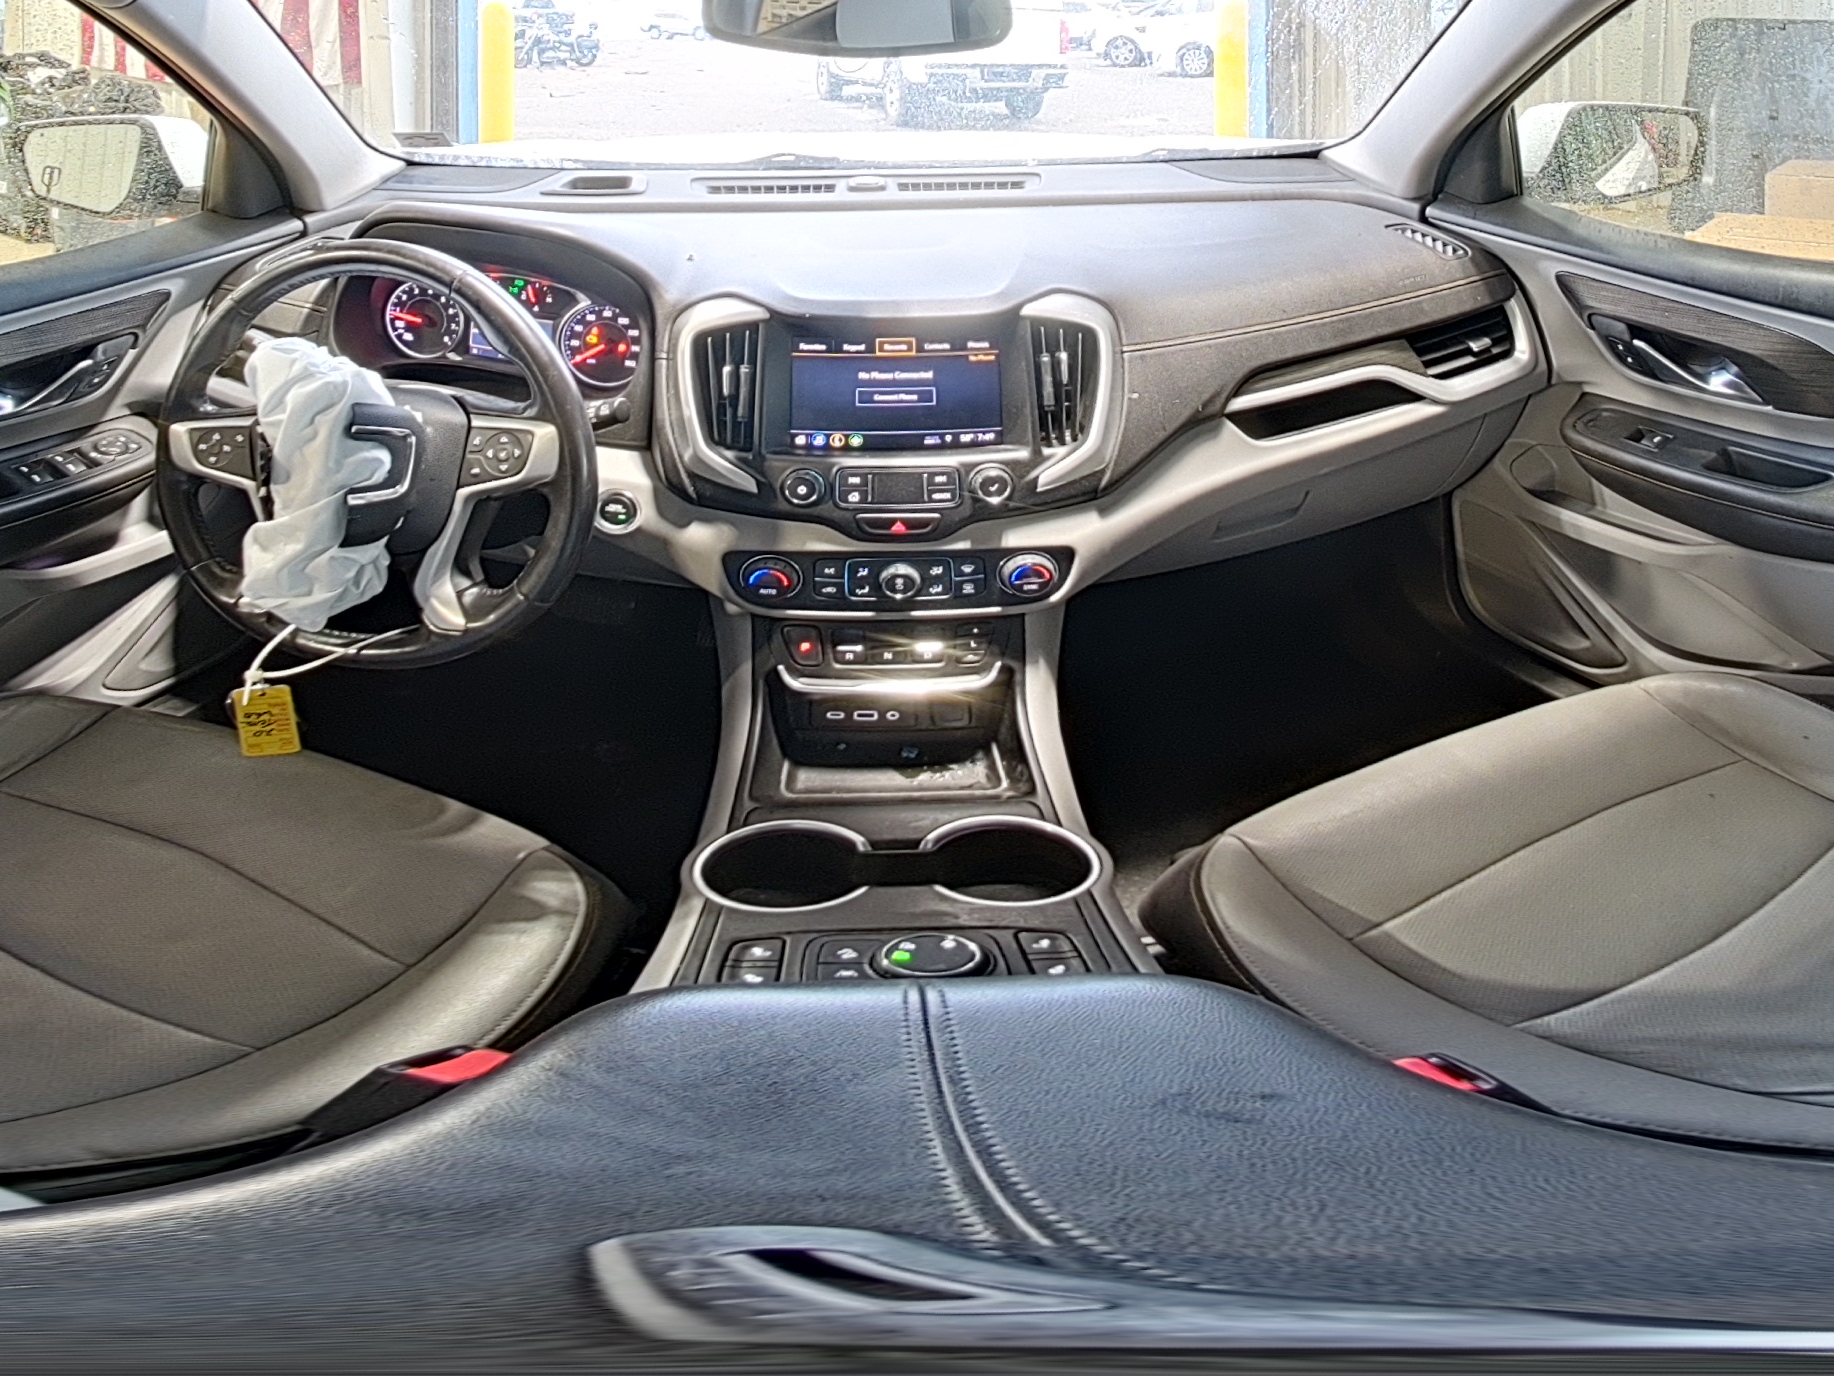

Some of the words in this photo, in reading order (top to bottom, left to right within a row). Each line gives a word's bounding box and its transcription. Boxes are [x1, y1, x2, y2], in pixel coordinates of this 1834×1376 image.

[858, 371, 870, 380] No
[870, 371, 894, 380] Phone
[894, 370, 934, 380] Connected
[883, 652, 893, 660] N
